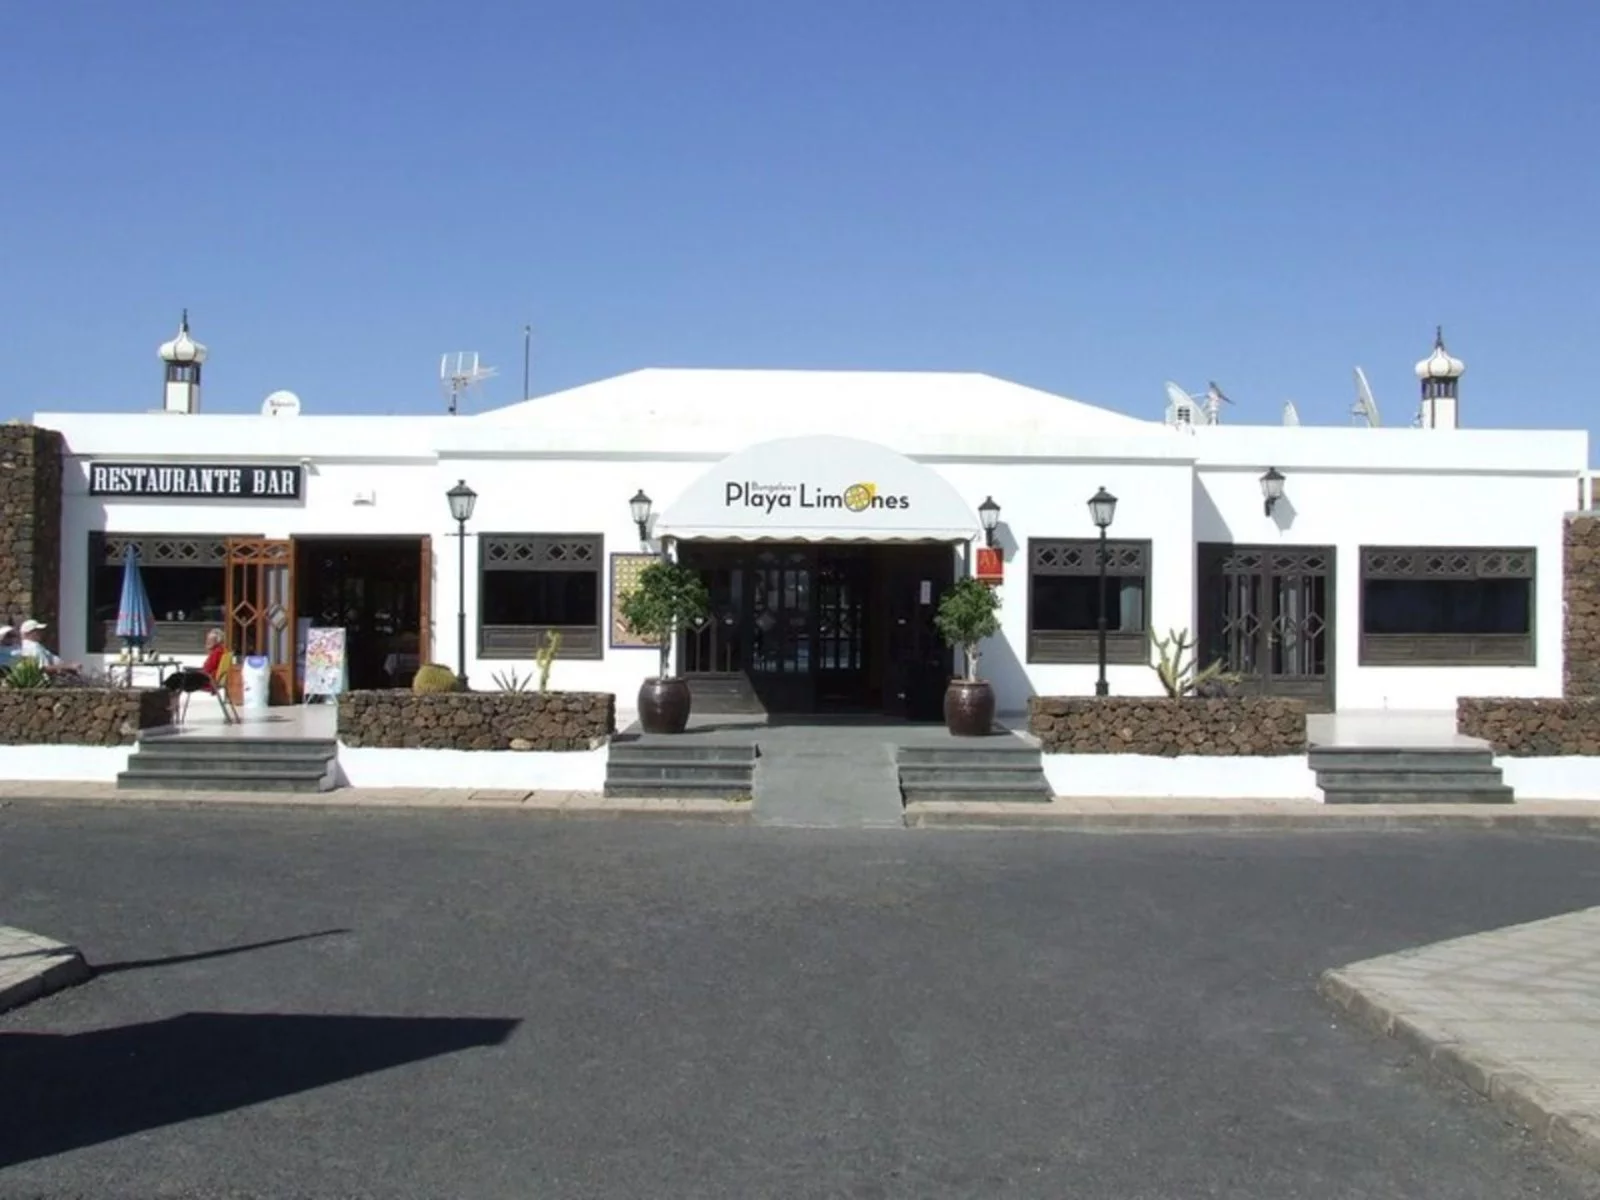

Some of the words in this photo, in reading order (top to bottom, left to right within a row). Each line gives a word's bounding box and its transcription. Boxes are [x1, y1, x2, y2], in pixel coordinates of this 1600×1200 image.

[94, 466, 241, 493] RESTAURANTE
[252, 468, 295, 495] BAR
[725, 481, 791, 515] Playa
